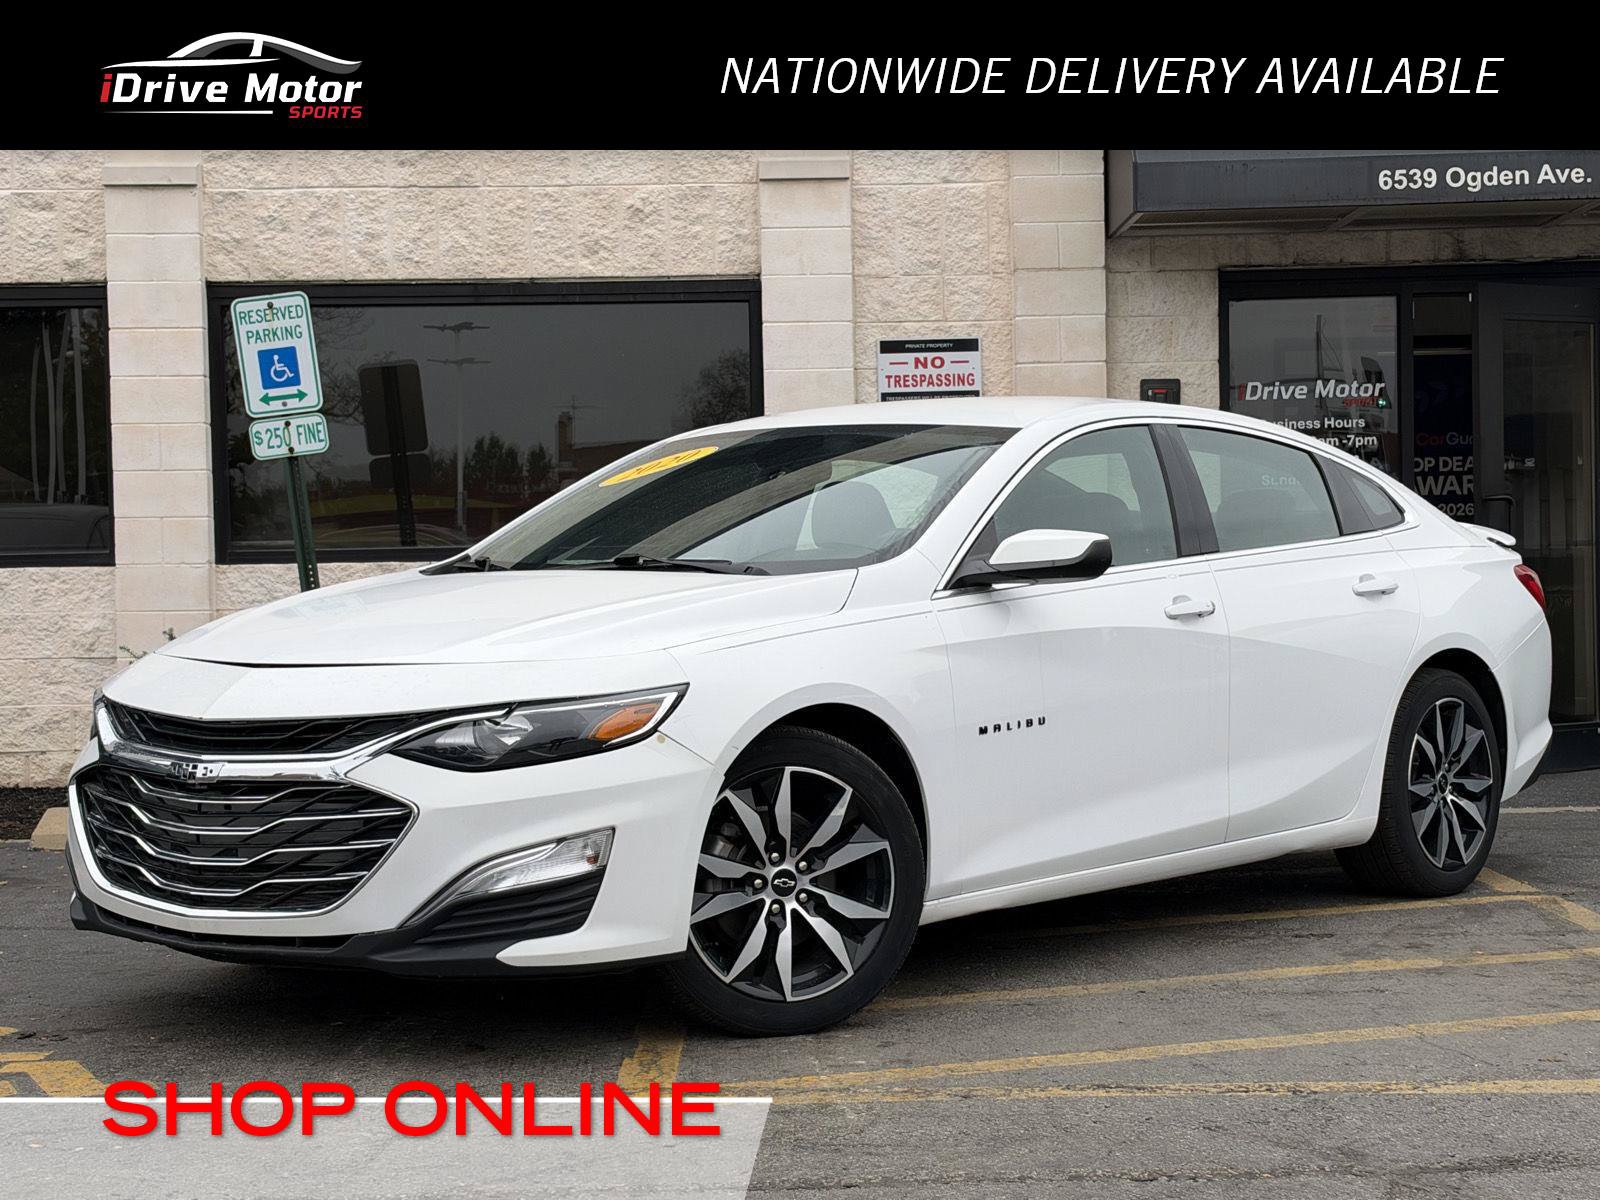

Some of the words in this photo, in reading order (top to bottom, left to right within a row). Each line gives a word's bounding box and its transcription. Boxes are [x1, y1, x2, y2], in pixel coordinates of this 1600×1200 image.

[1378, 169, 1437, 190] 6539
[1445, 165, 1530, 192] Ogden
[1536, 163, 1592, 184] Ave.
[239, 304, 304, 326] RESERVED
[246, 325, 303, 345] PARKING
[914, 356, 945, 370] NO
[885, 373, 976, 388] TRESPASSING
[1314, 379, 1386, 399] Motor
[1272, 418, 1321, 430] siness
[1324, 417, 1366, 429] Hours
[254, 424, 292, 450] $250
[296, 422, 325, 446] FINE
[1413, 457, 1436, 472] OP
[1414, 475, 1474, 495] WAR
[978, 716, 1046, 736] MALIBU
